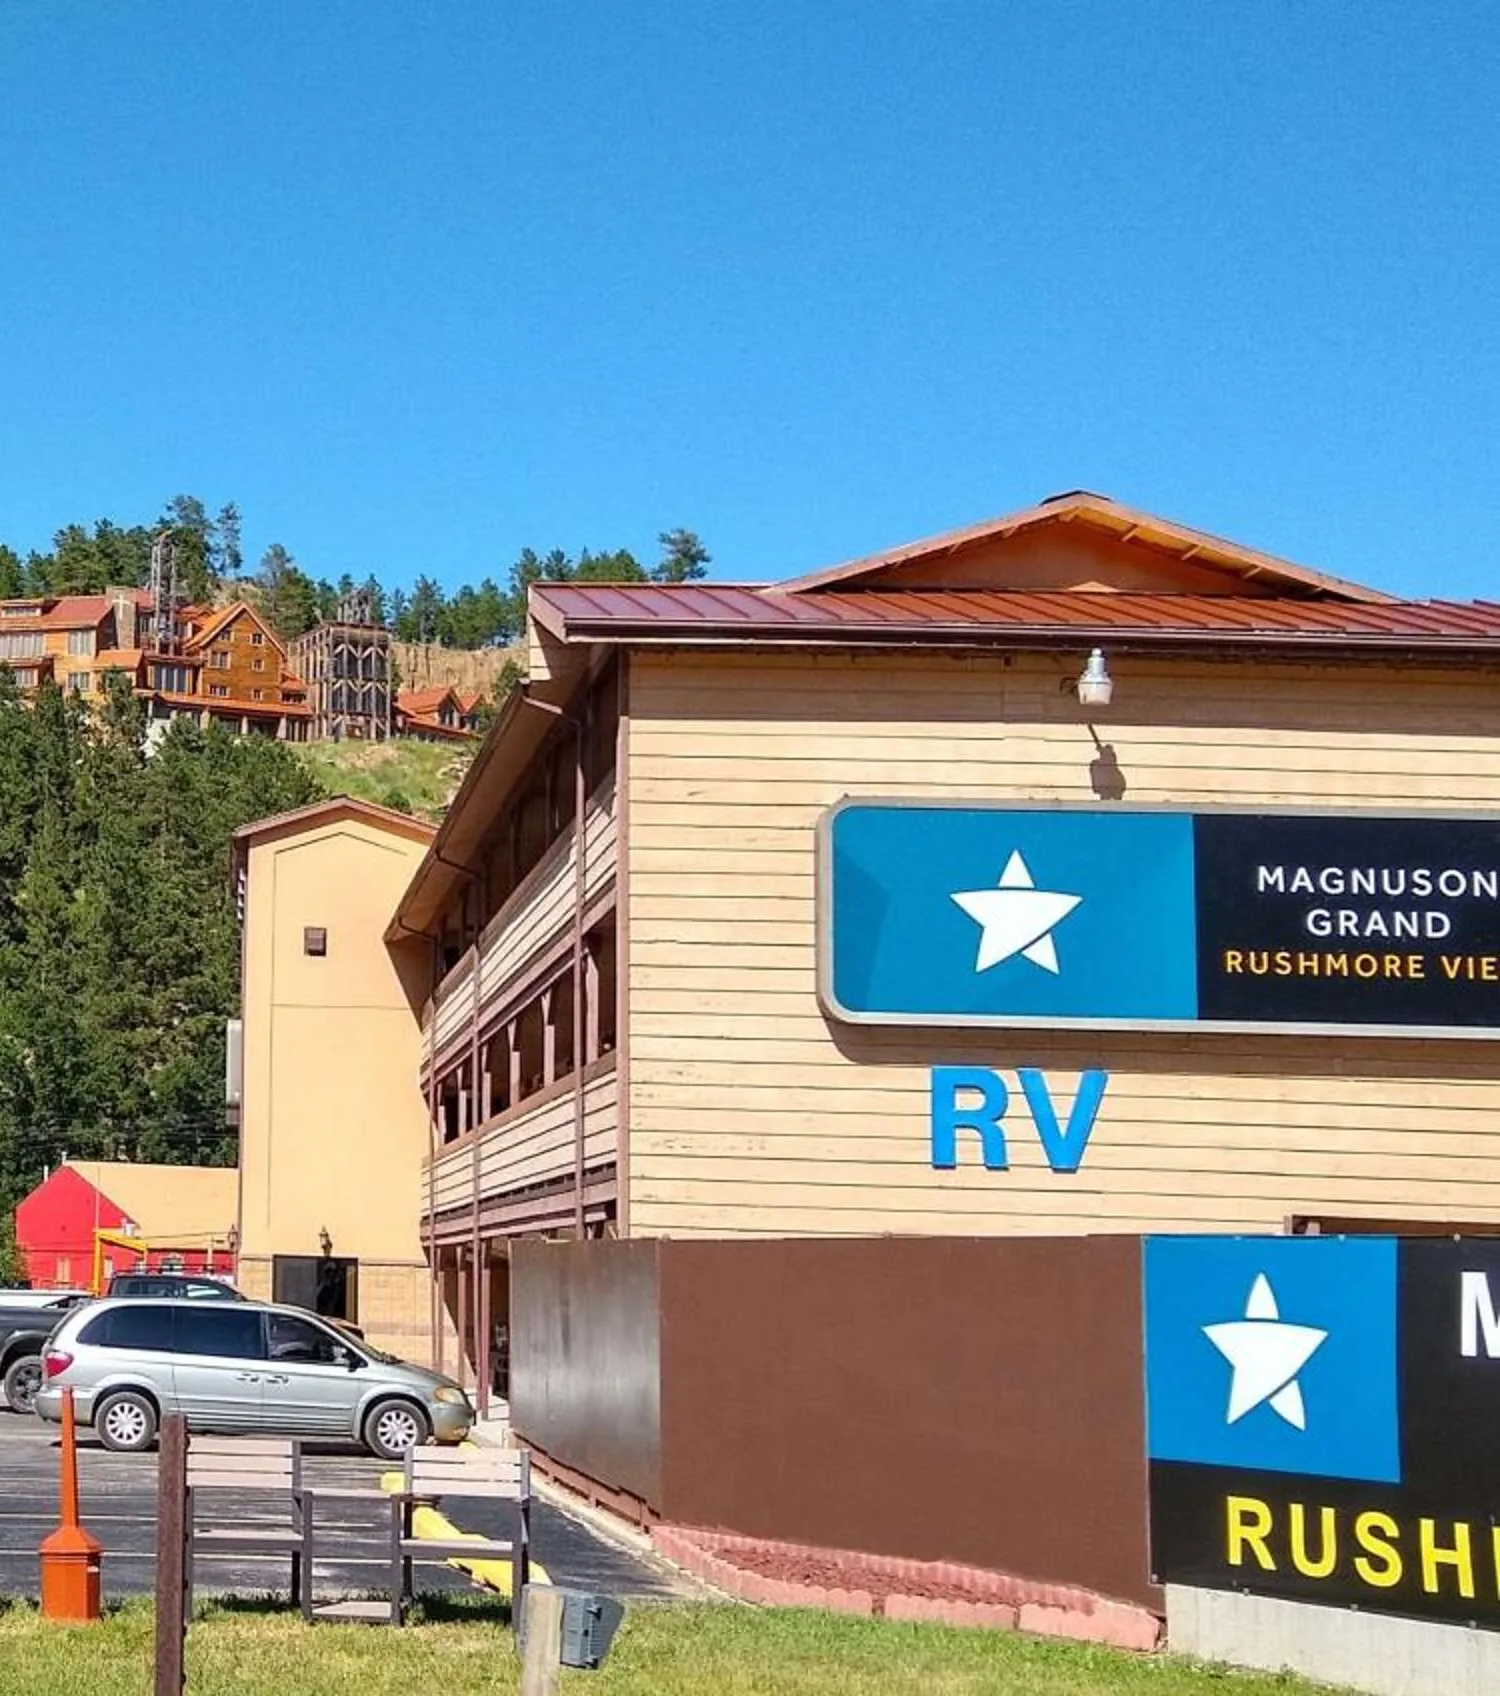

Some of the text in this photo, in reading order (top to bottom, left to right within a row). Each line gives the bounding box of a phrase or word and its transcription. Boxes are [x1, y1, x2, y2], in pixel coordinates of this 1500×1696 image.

[1257, 865, 1498, 898] MAGNUSON
[1306, 908, 1450, 938] GRAND
[1226, 950, 1425, 978] RUSHMORE
[931, 1065, 1109, 1174] RV
[1227, 1496, 1500, 1600] RUSH
